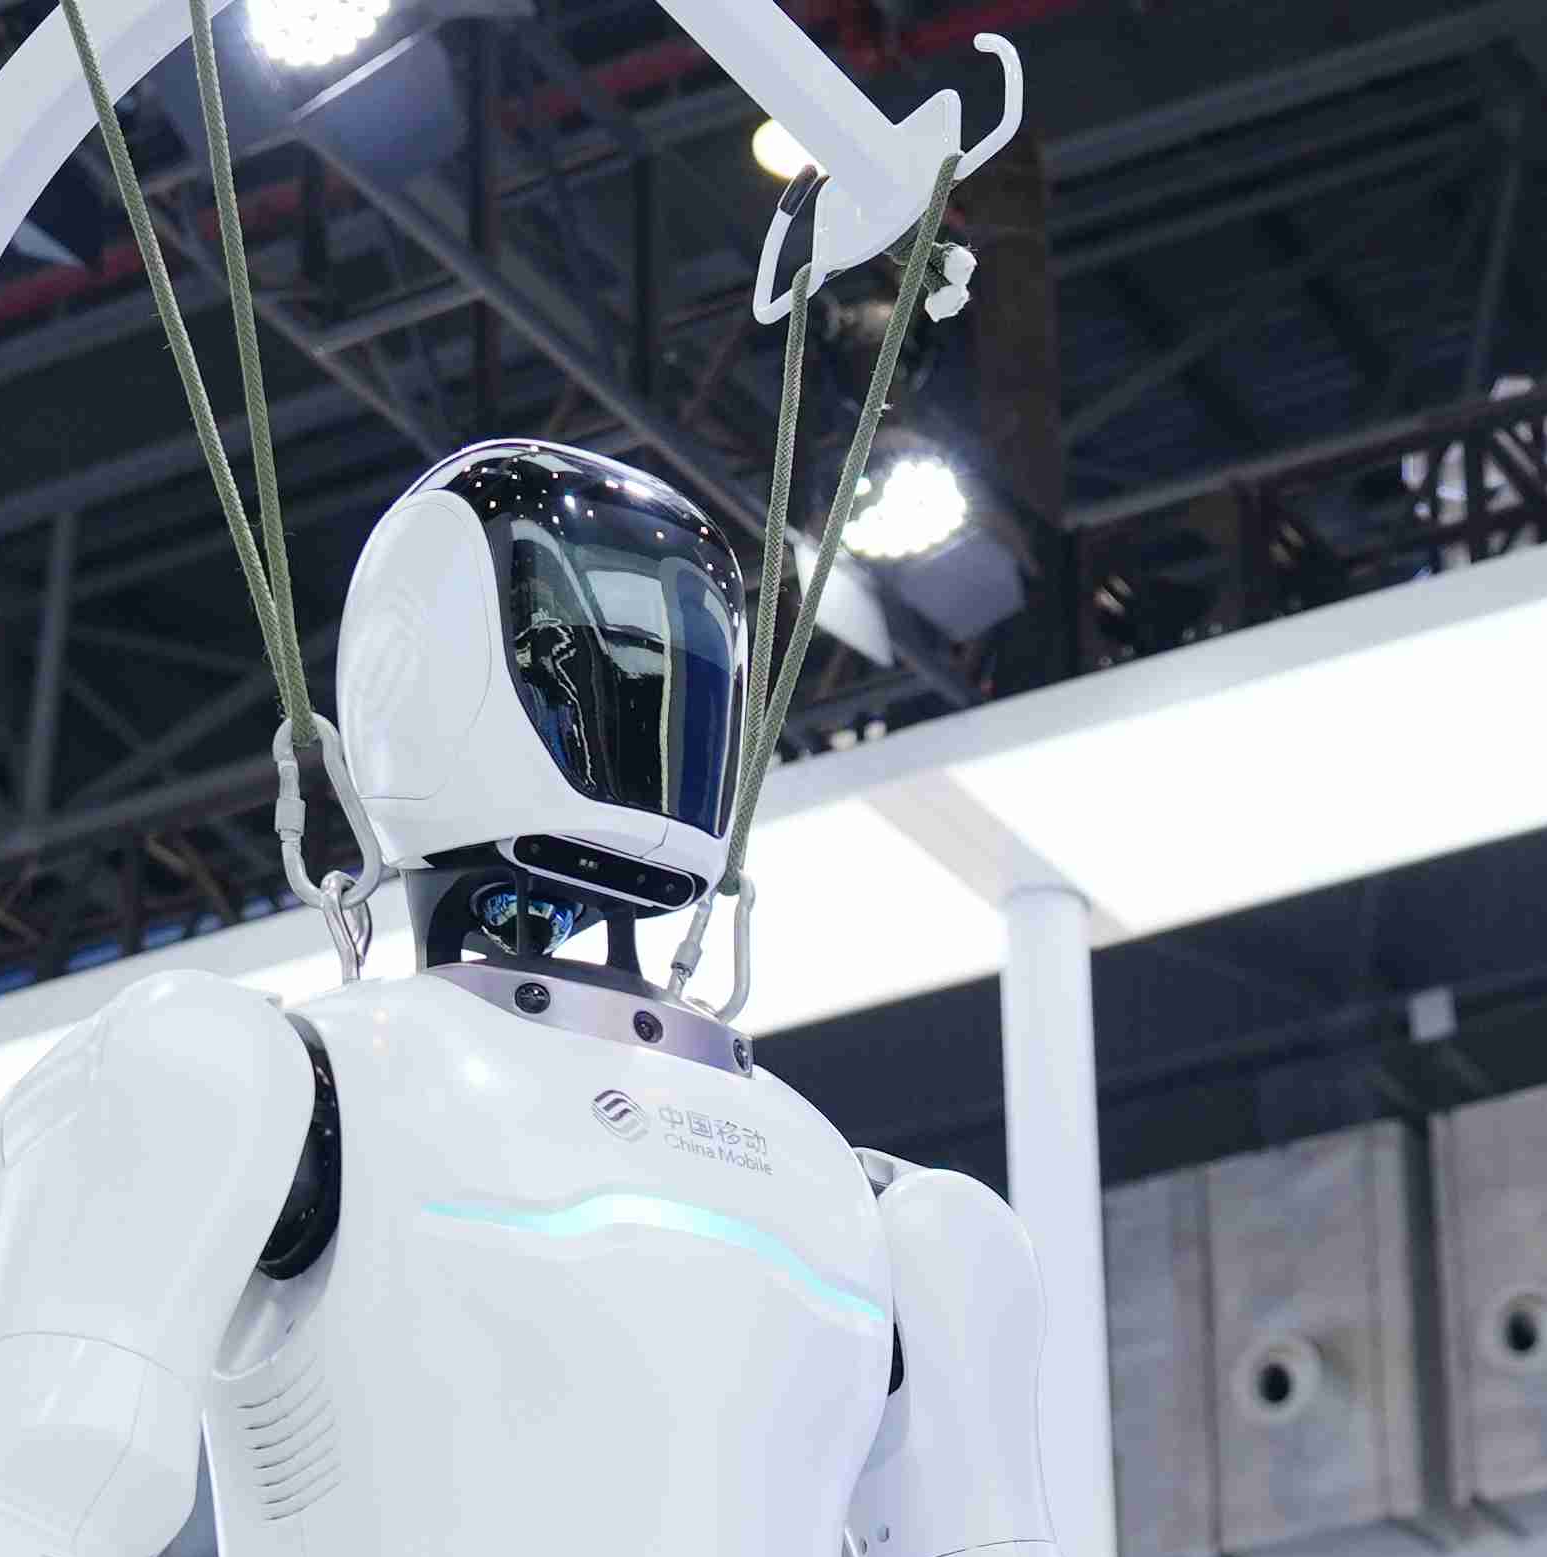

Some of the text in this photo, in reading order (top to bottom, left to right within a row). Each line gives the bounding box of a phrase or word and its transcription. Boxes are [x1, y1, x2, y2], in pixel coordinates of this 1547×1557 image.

[659, 1106, 767, 1155] 中国移动
[664, 1133, 773, 1175] China Mobile
